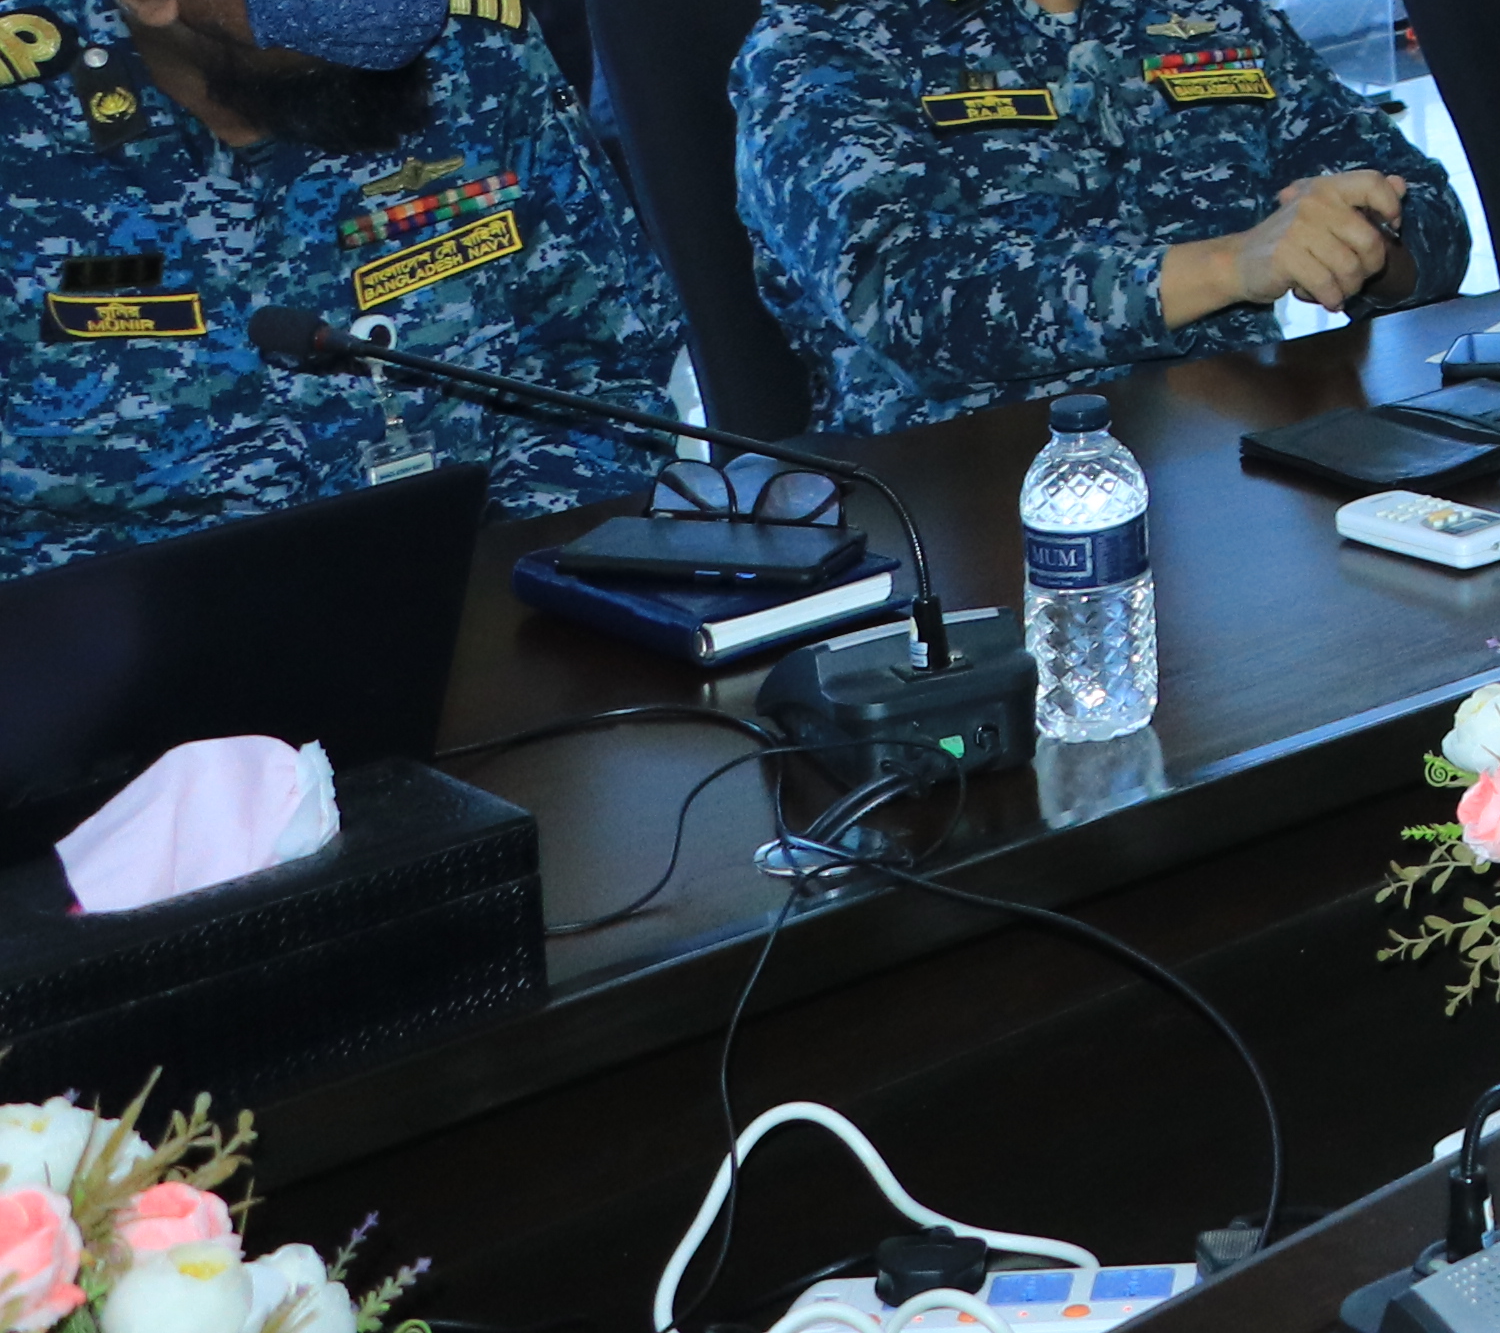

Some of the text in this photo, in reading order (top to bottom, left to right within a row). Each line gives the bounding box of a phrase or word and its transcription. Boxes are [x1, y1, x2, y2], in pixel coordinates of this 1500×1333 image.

[364, 234, 511, 301] BANGLADESH NAVY
[87, 319, 156, 332] MUNIR
[1031, 545, 1079, 567] MUM
